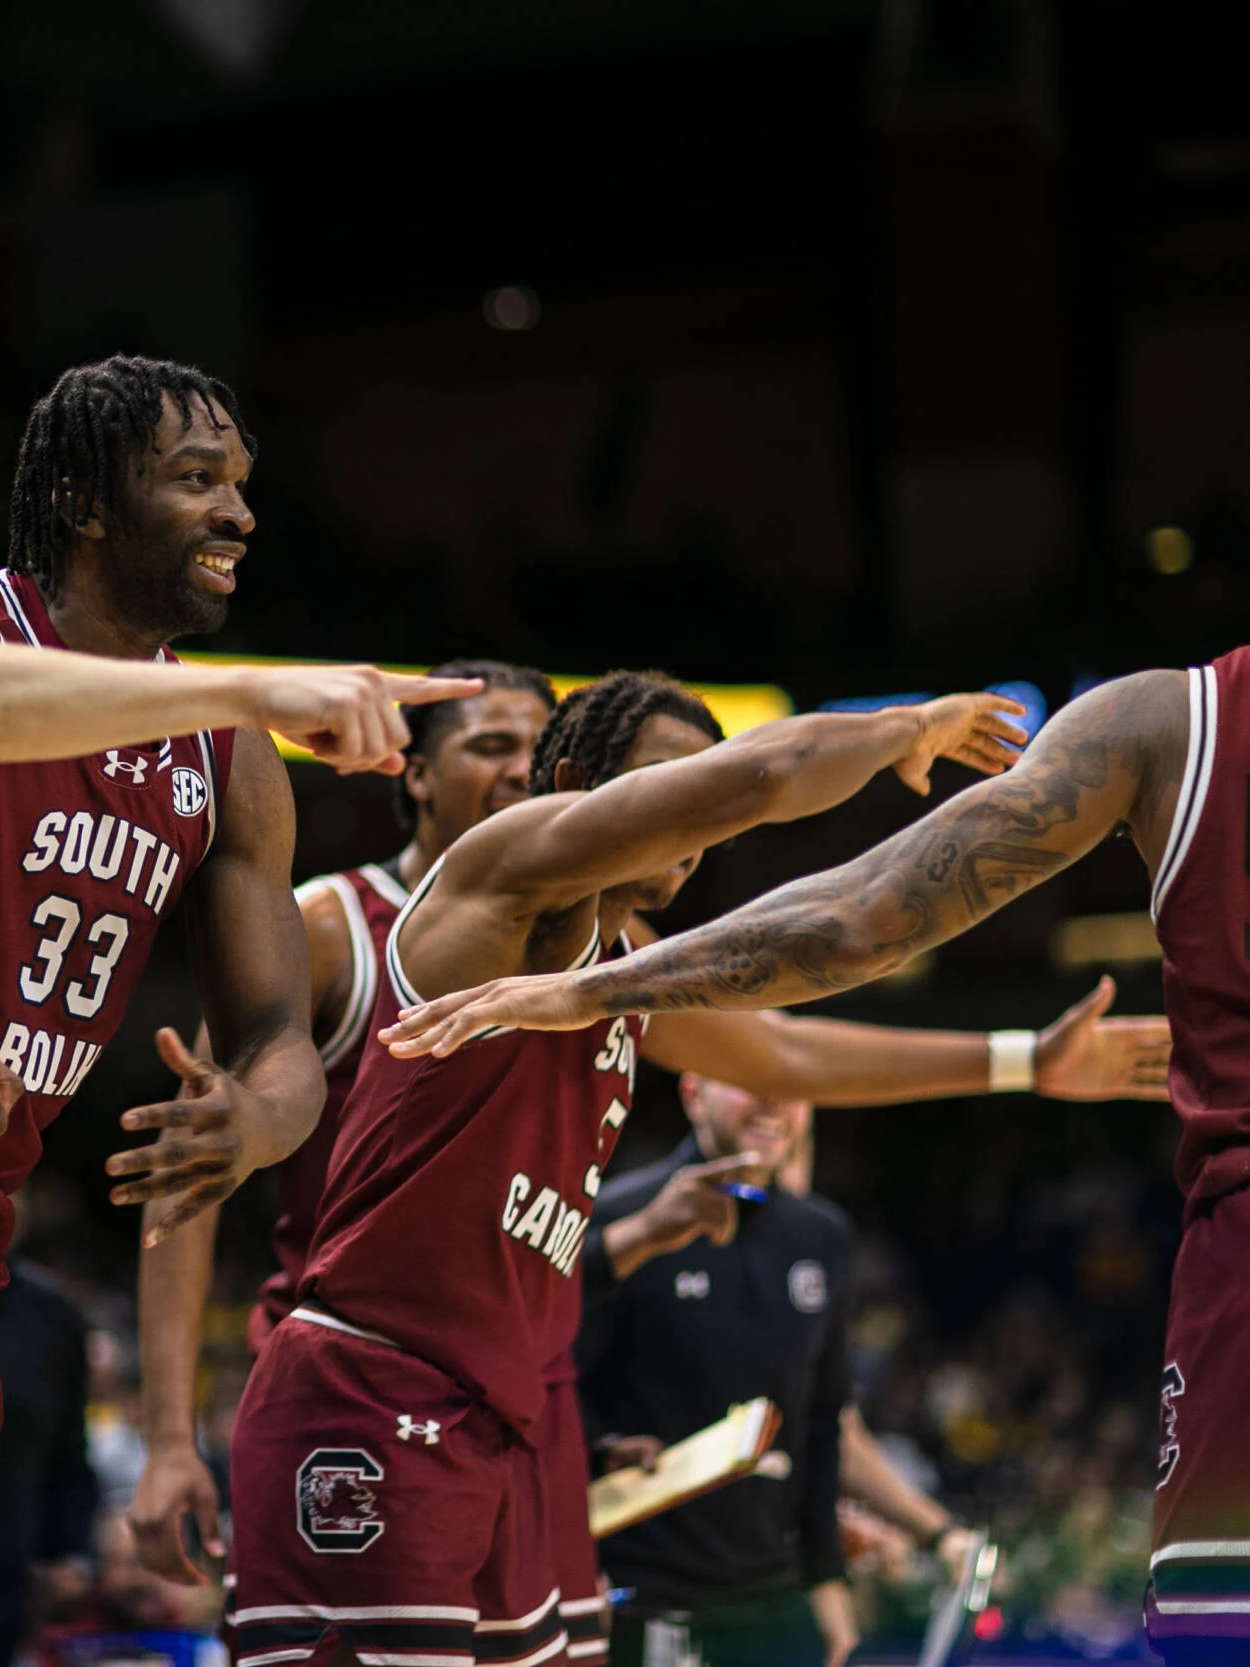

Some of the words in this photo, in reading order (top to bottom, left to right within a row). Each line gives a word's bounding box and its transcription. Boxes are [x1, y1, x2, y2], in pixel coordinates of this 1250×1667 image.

[172, 768, 206, 815] SEC
[21, 810, 181, 916] SOUTH
[18, 893, 131, 1019] 33
[296, 1449, 385, 1553] C
